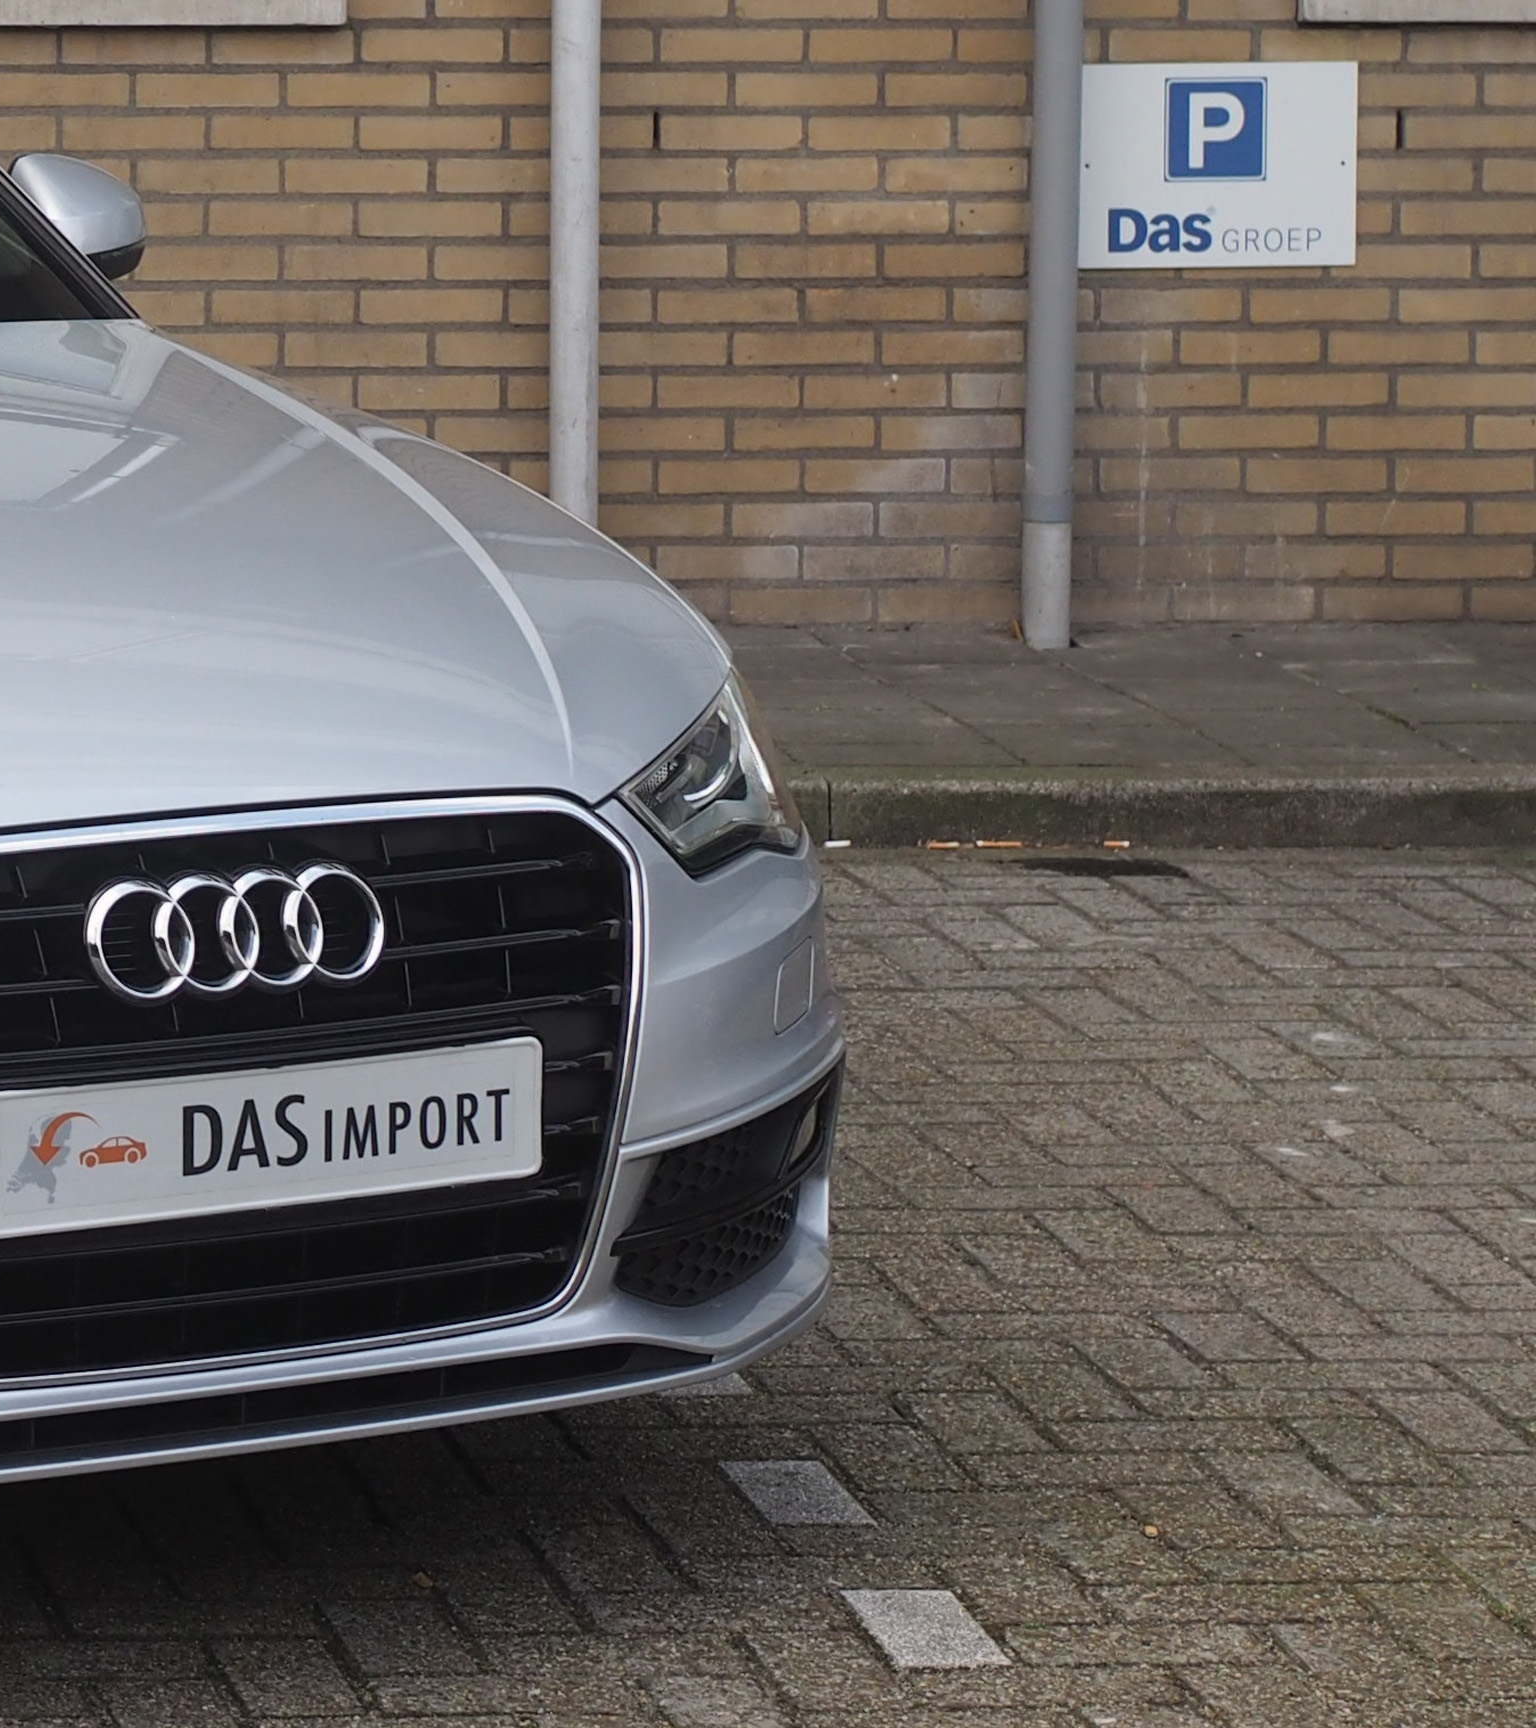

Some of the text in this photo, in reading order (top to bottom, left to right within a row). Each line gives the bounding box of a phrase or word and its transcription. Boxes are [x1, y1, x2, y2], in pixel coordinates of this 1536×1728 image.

[1188, 92, 1245, 168] P
[1107, 208, 1322, 253] Das GROEP
[182, 1087, 512, 1177] DAS IMPORT
